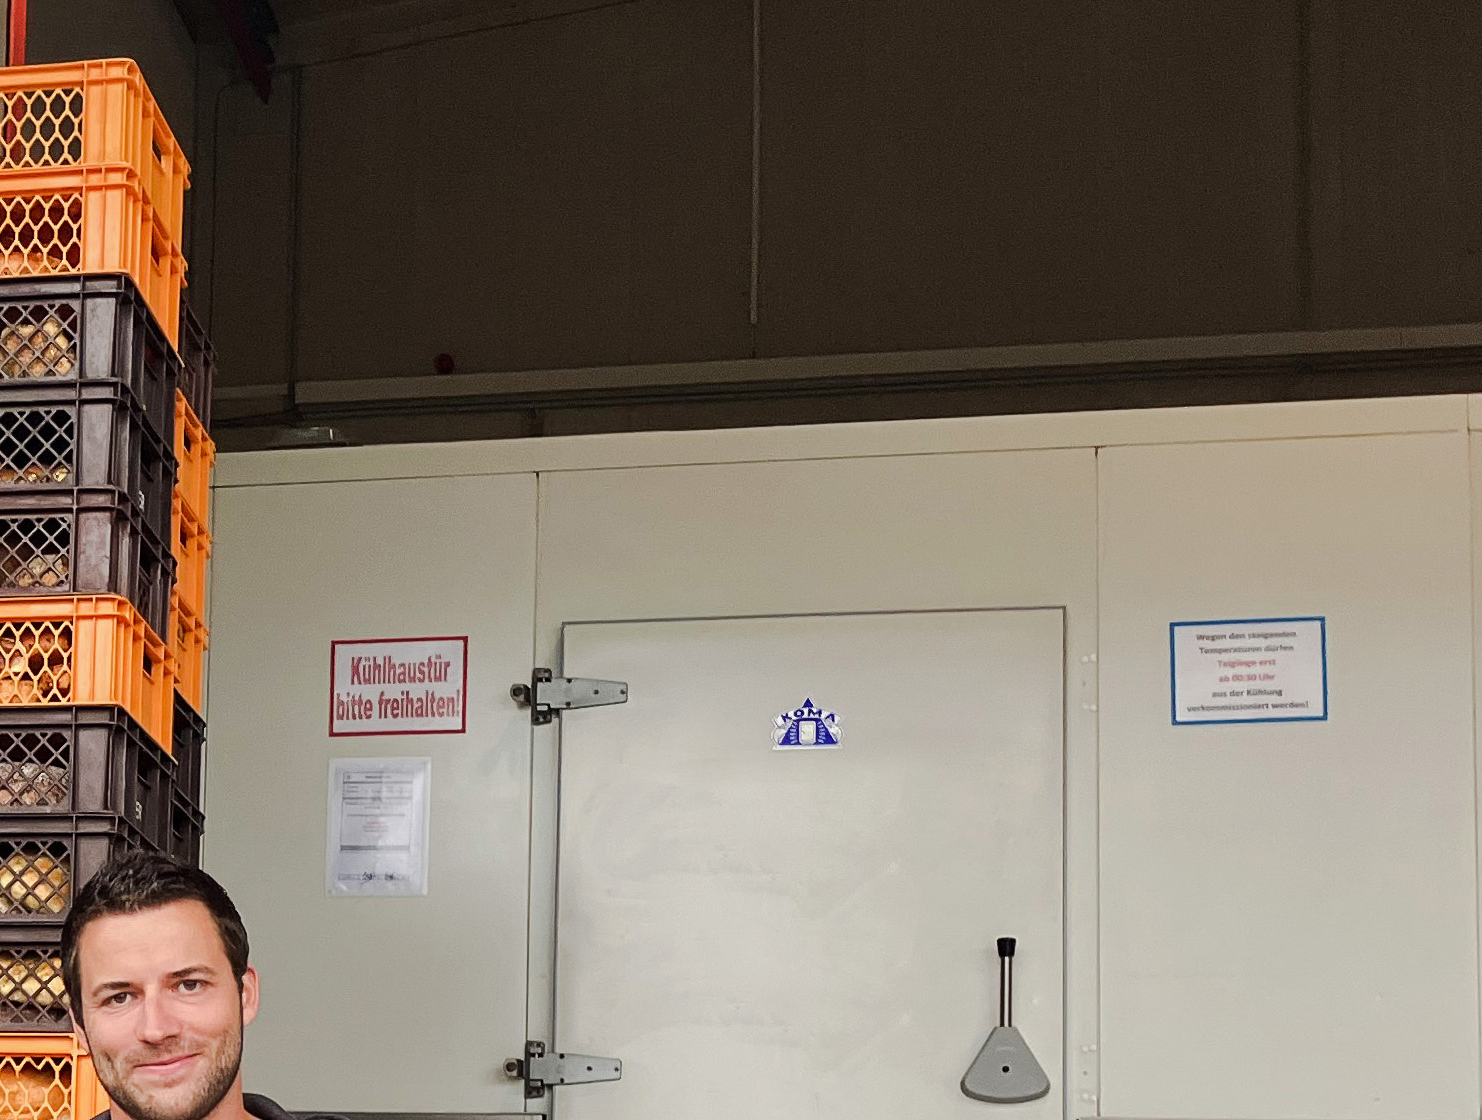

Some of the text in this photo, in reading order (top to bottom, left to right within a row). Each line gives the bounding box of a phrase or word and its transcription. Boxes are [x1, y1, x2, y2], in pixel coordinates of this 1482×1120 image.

[1229, 632, 1246, 640] den
[1199, 644, 1294, 654] Temperaturen dürfen
[350, 654, 451, 685] Kühlhaustür
[1219, 675, 1230, 683] ab
[1212, 688, 1283, 698] aus der Kühlung
[335, 689, 460, 721] bitte freihalten!
[1271, 701, 1310, 710] werden!
[780, 708, 836, 723] KOMA
